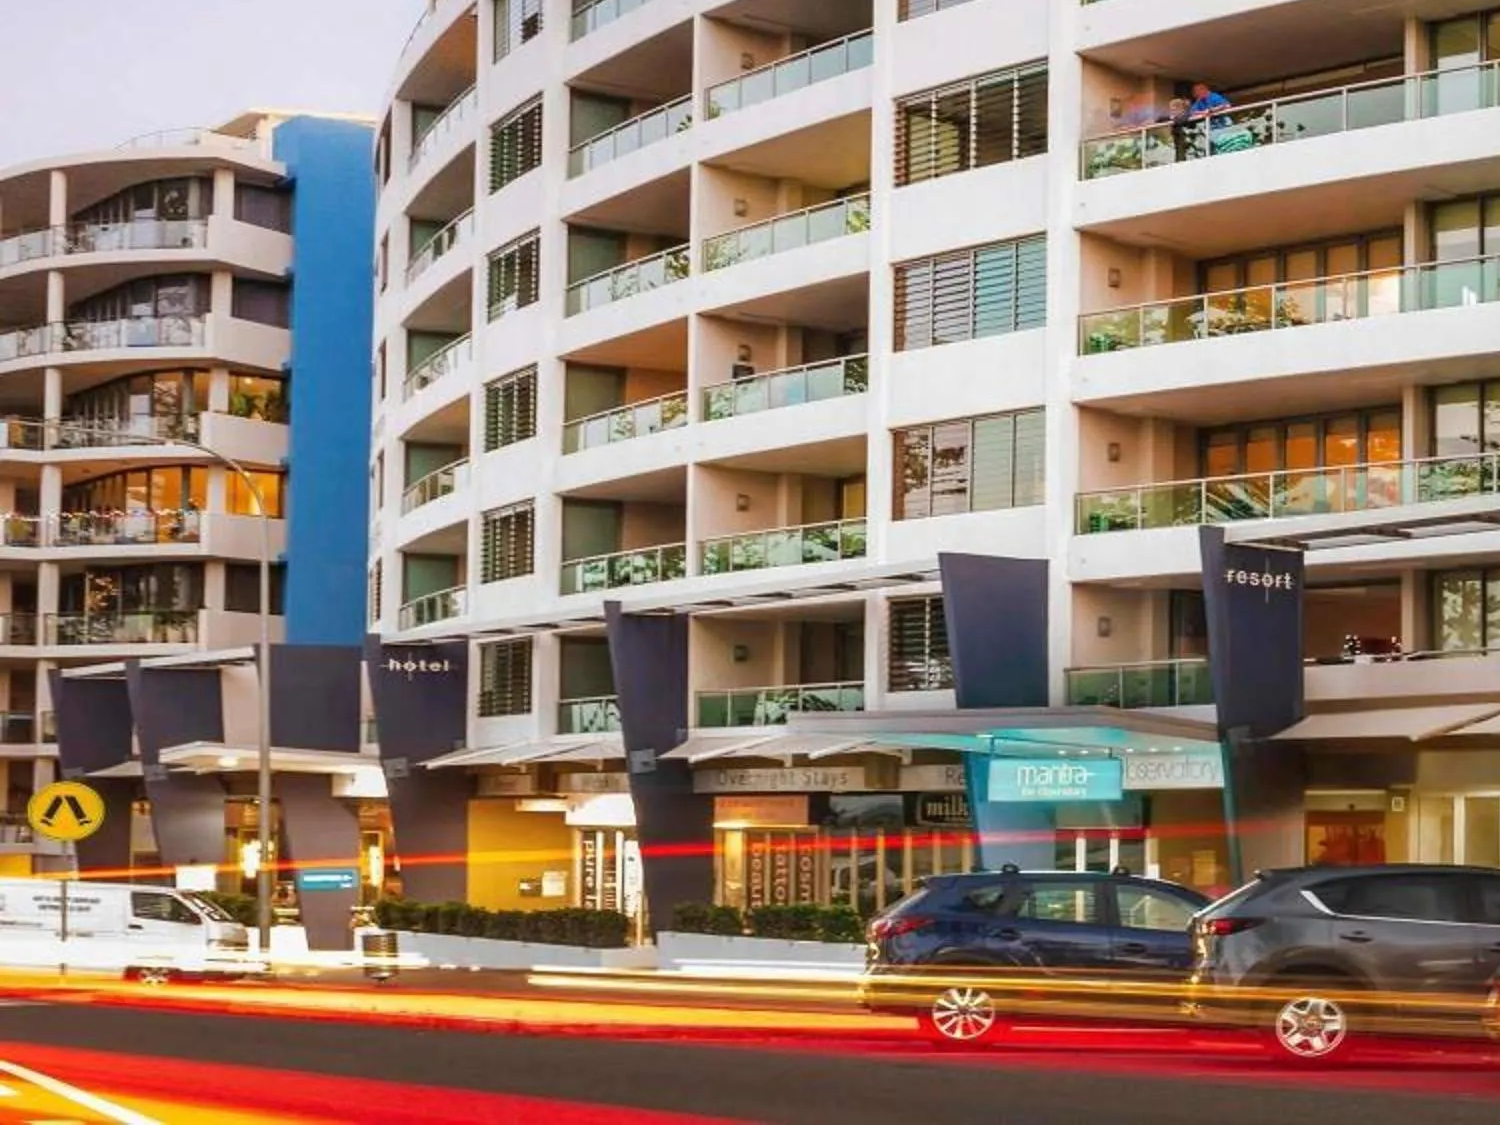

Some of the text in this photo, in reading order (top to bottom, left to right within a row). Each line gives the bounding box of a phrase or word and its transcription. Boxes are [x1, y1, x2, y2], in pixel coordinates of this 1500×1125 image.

[1226, 569, 1293, 590] resort
[388, 658, 450, 672] hotel
[803, 769, 849, 789] Stays
[1016, 762, 1088, 786] mantra
